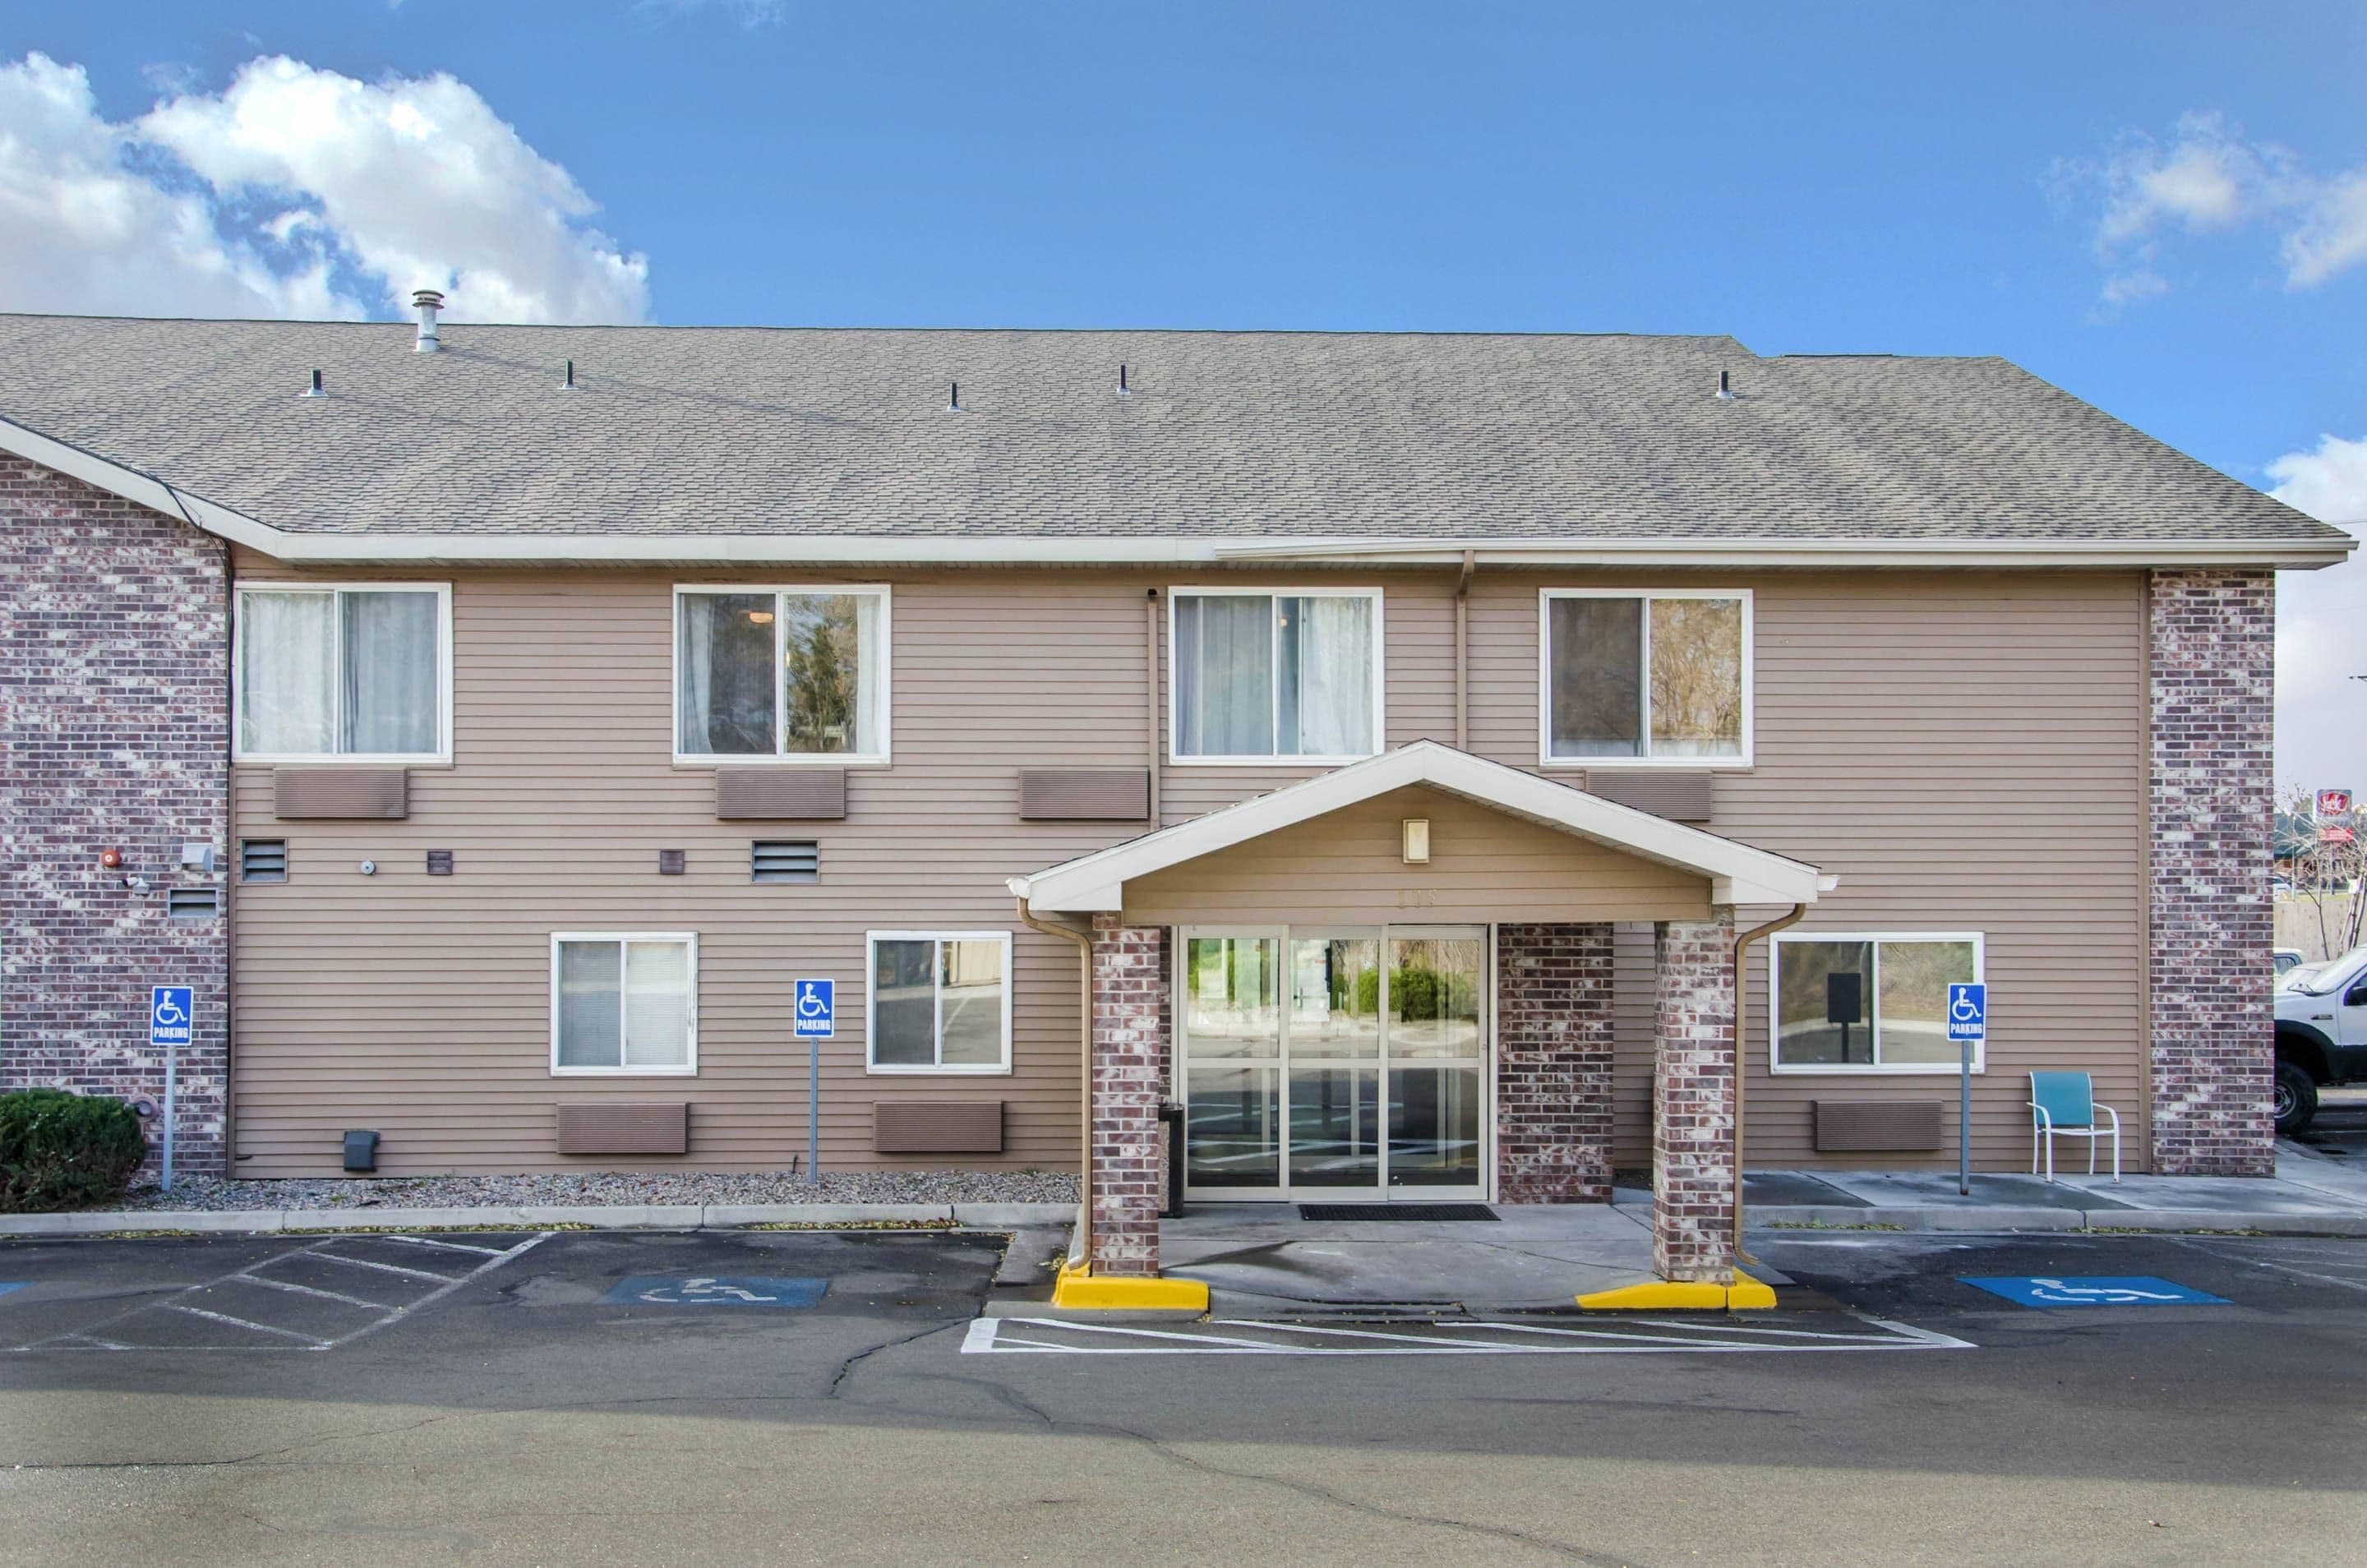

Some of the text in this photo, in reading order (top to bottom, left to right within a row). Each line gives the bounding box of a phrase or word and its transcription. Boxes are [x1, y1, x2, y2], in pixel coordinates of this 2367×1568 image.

[797, 1019, 831, 1031] PARKING
[1950, 1023, 1982, 1034] PARKING
[154, 1026, 188, 1038] PARKING
